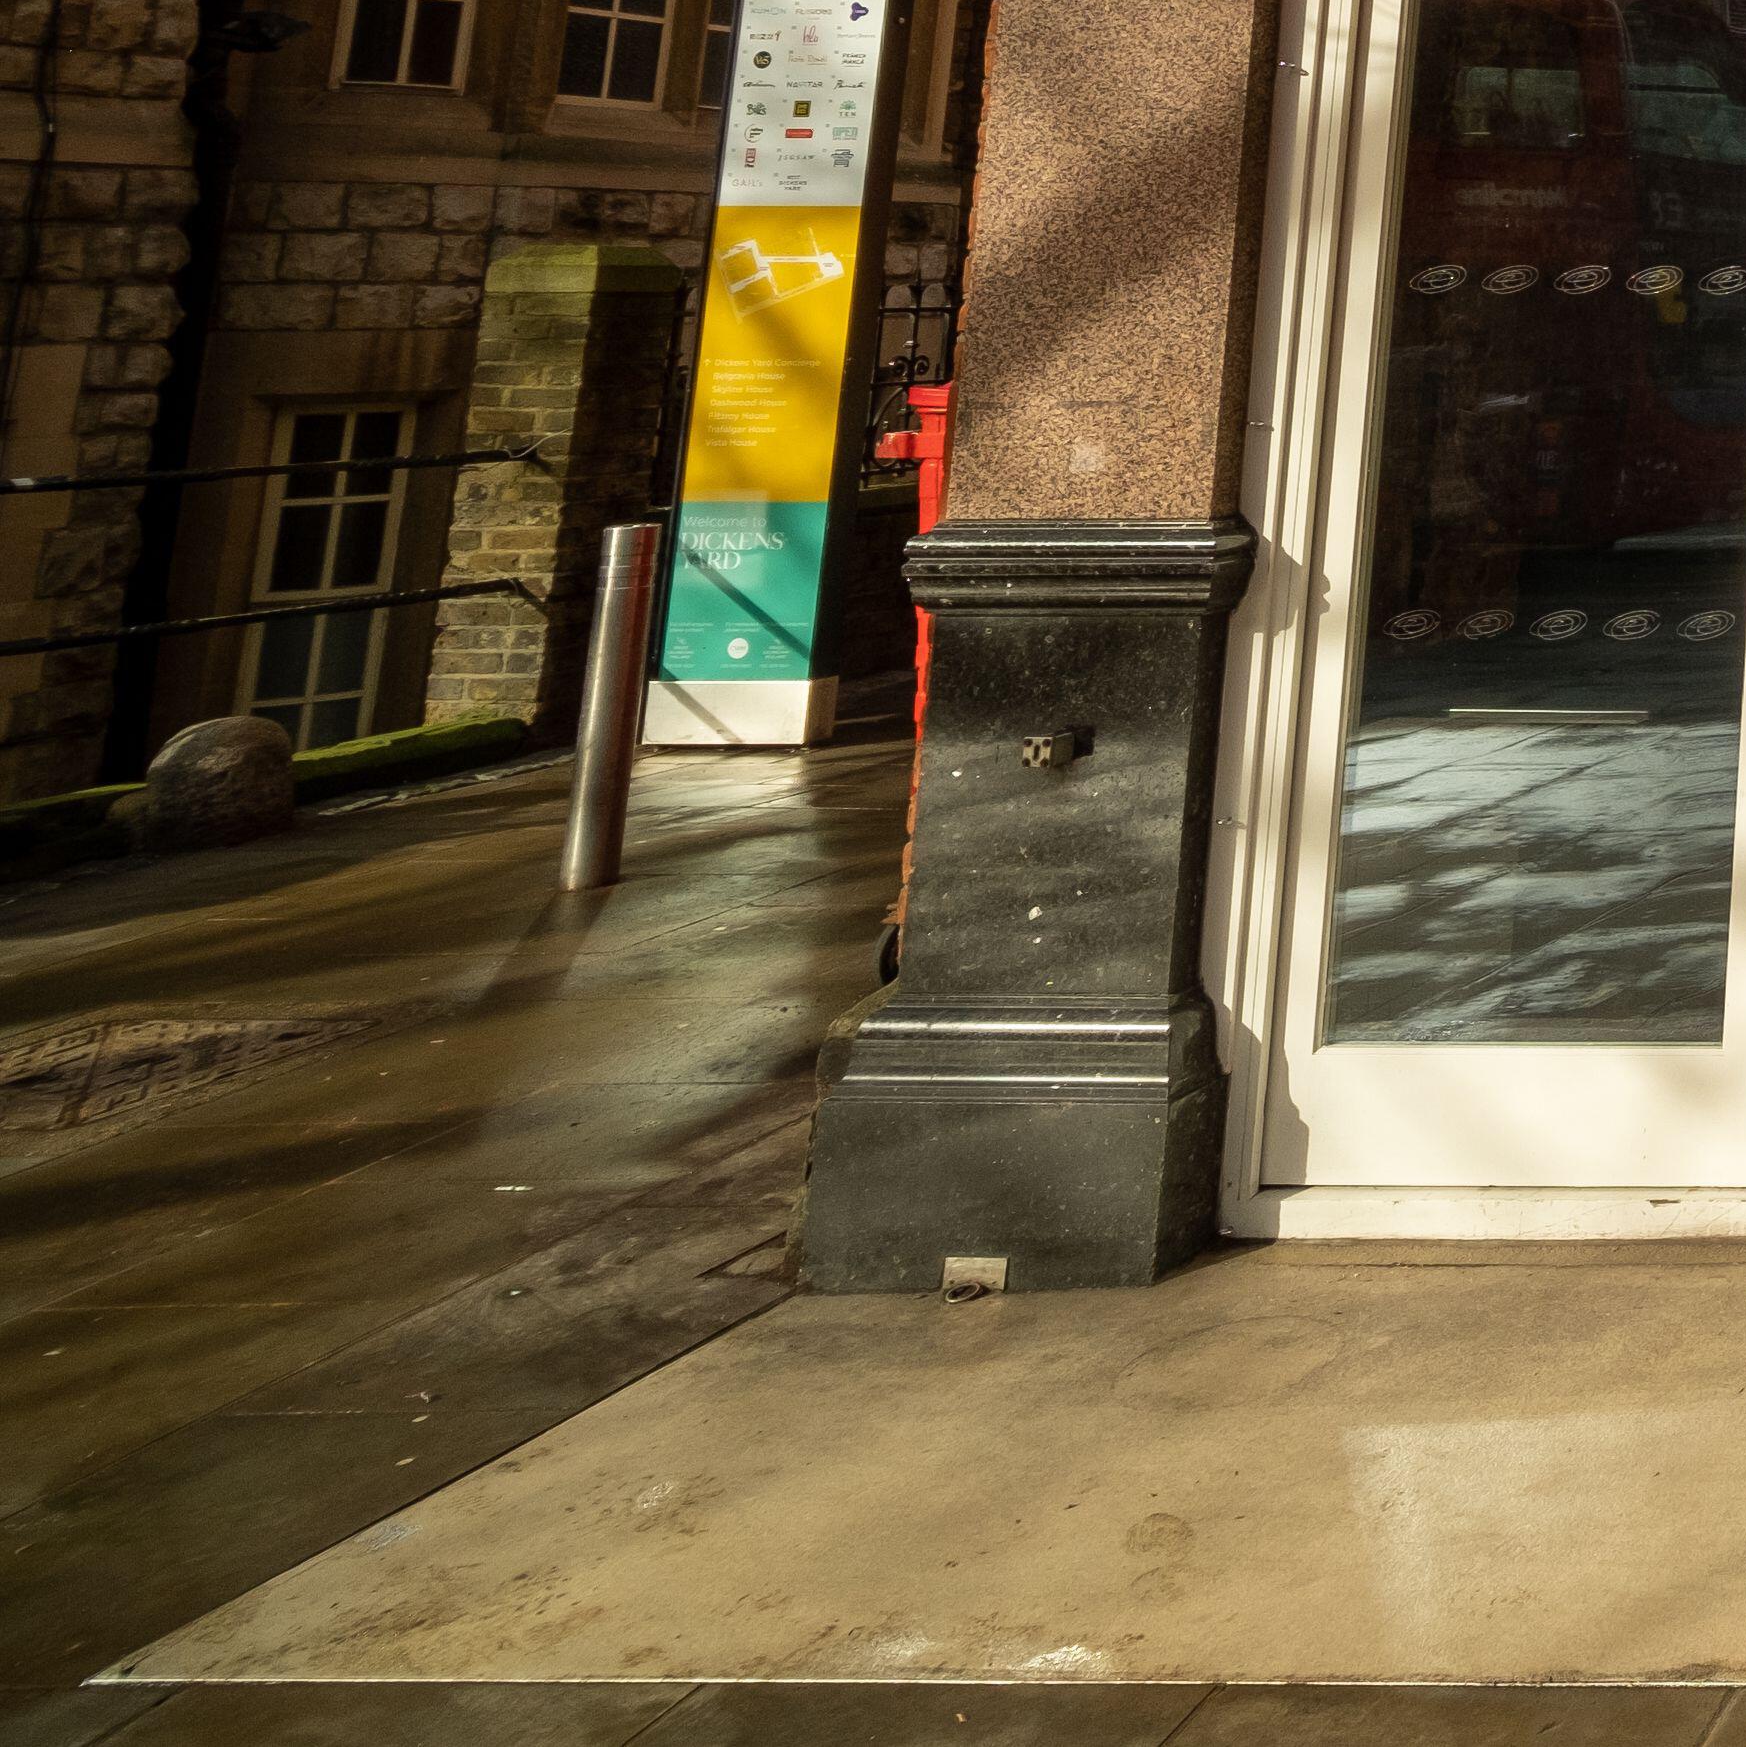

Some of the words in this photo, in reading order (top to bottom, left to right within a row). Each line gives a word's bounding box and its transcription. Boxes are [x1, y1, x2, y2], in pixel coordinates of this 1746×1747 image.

[714, 358, 749, 367] Dickens
[752, 358, 773, 367] Yard
[774, 358, 822, 368] Concierge
[712, 372, 755, 381] Belgravia
[757, 372, 786, 380] House
[711, 386, 744, 395] Skyline
[709, 399, 758, 407] Dashwood
[760, 399, 788, 407] House
[742, 412, 770, 420] House
[706, 425, 746, 434] Trafalgar
[704, 438, 728, 447] Vista
[730, 439, 758, 447] House
[683, 516, 749, 528] Welcome
[752, 516, 768, 528] to
[681, 531, 786, 551] DICKENS
